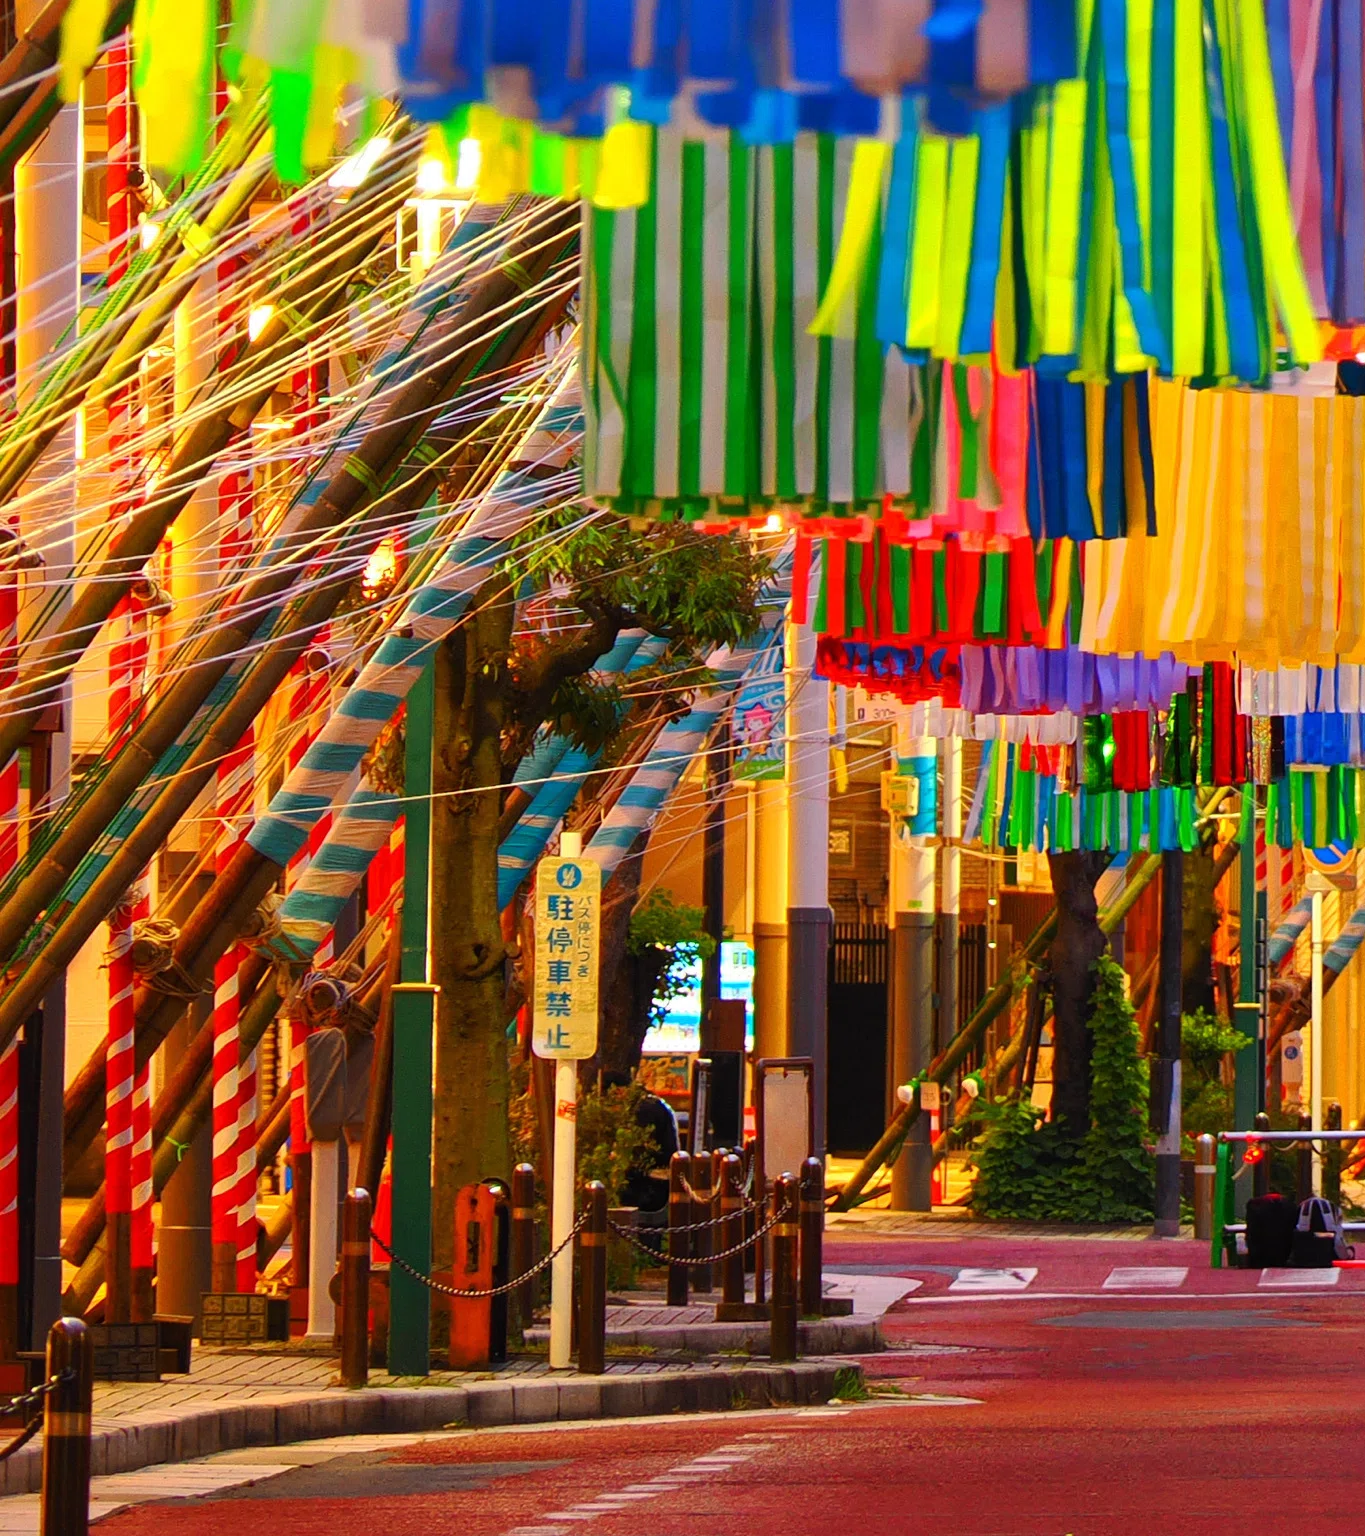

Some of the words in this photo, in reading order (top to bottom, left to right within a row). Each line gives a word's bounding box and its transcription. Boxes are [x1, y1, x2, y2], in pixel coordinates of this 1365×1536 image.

[544, 894, 574, 1050] 駐停車禁止
[577, 895, 592, 978] バス停につき
